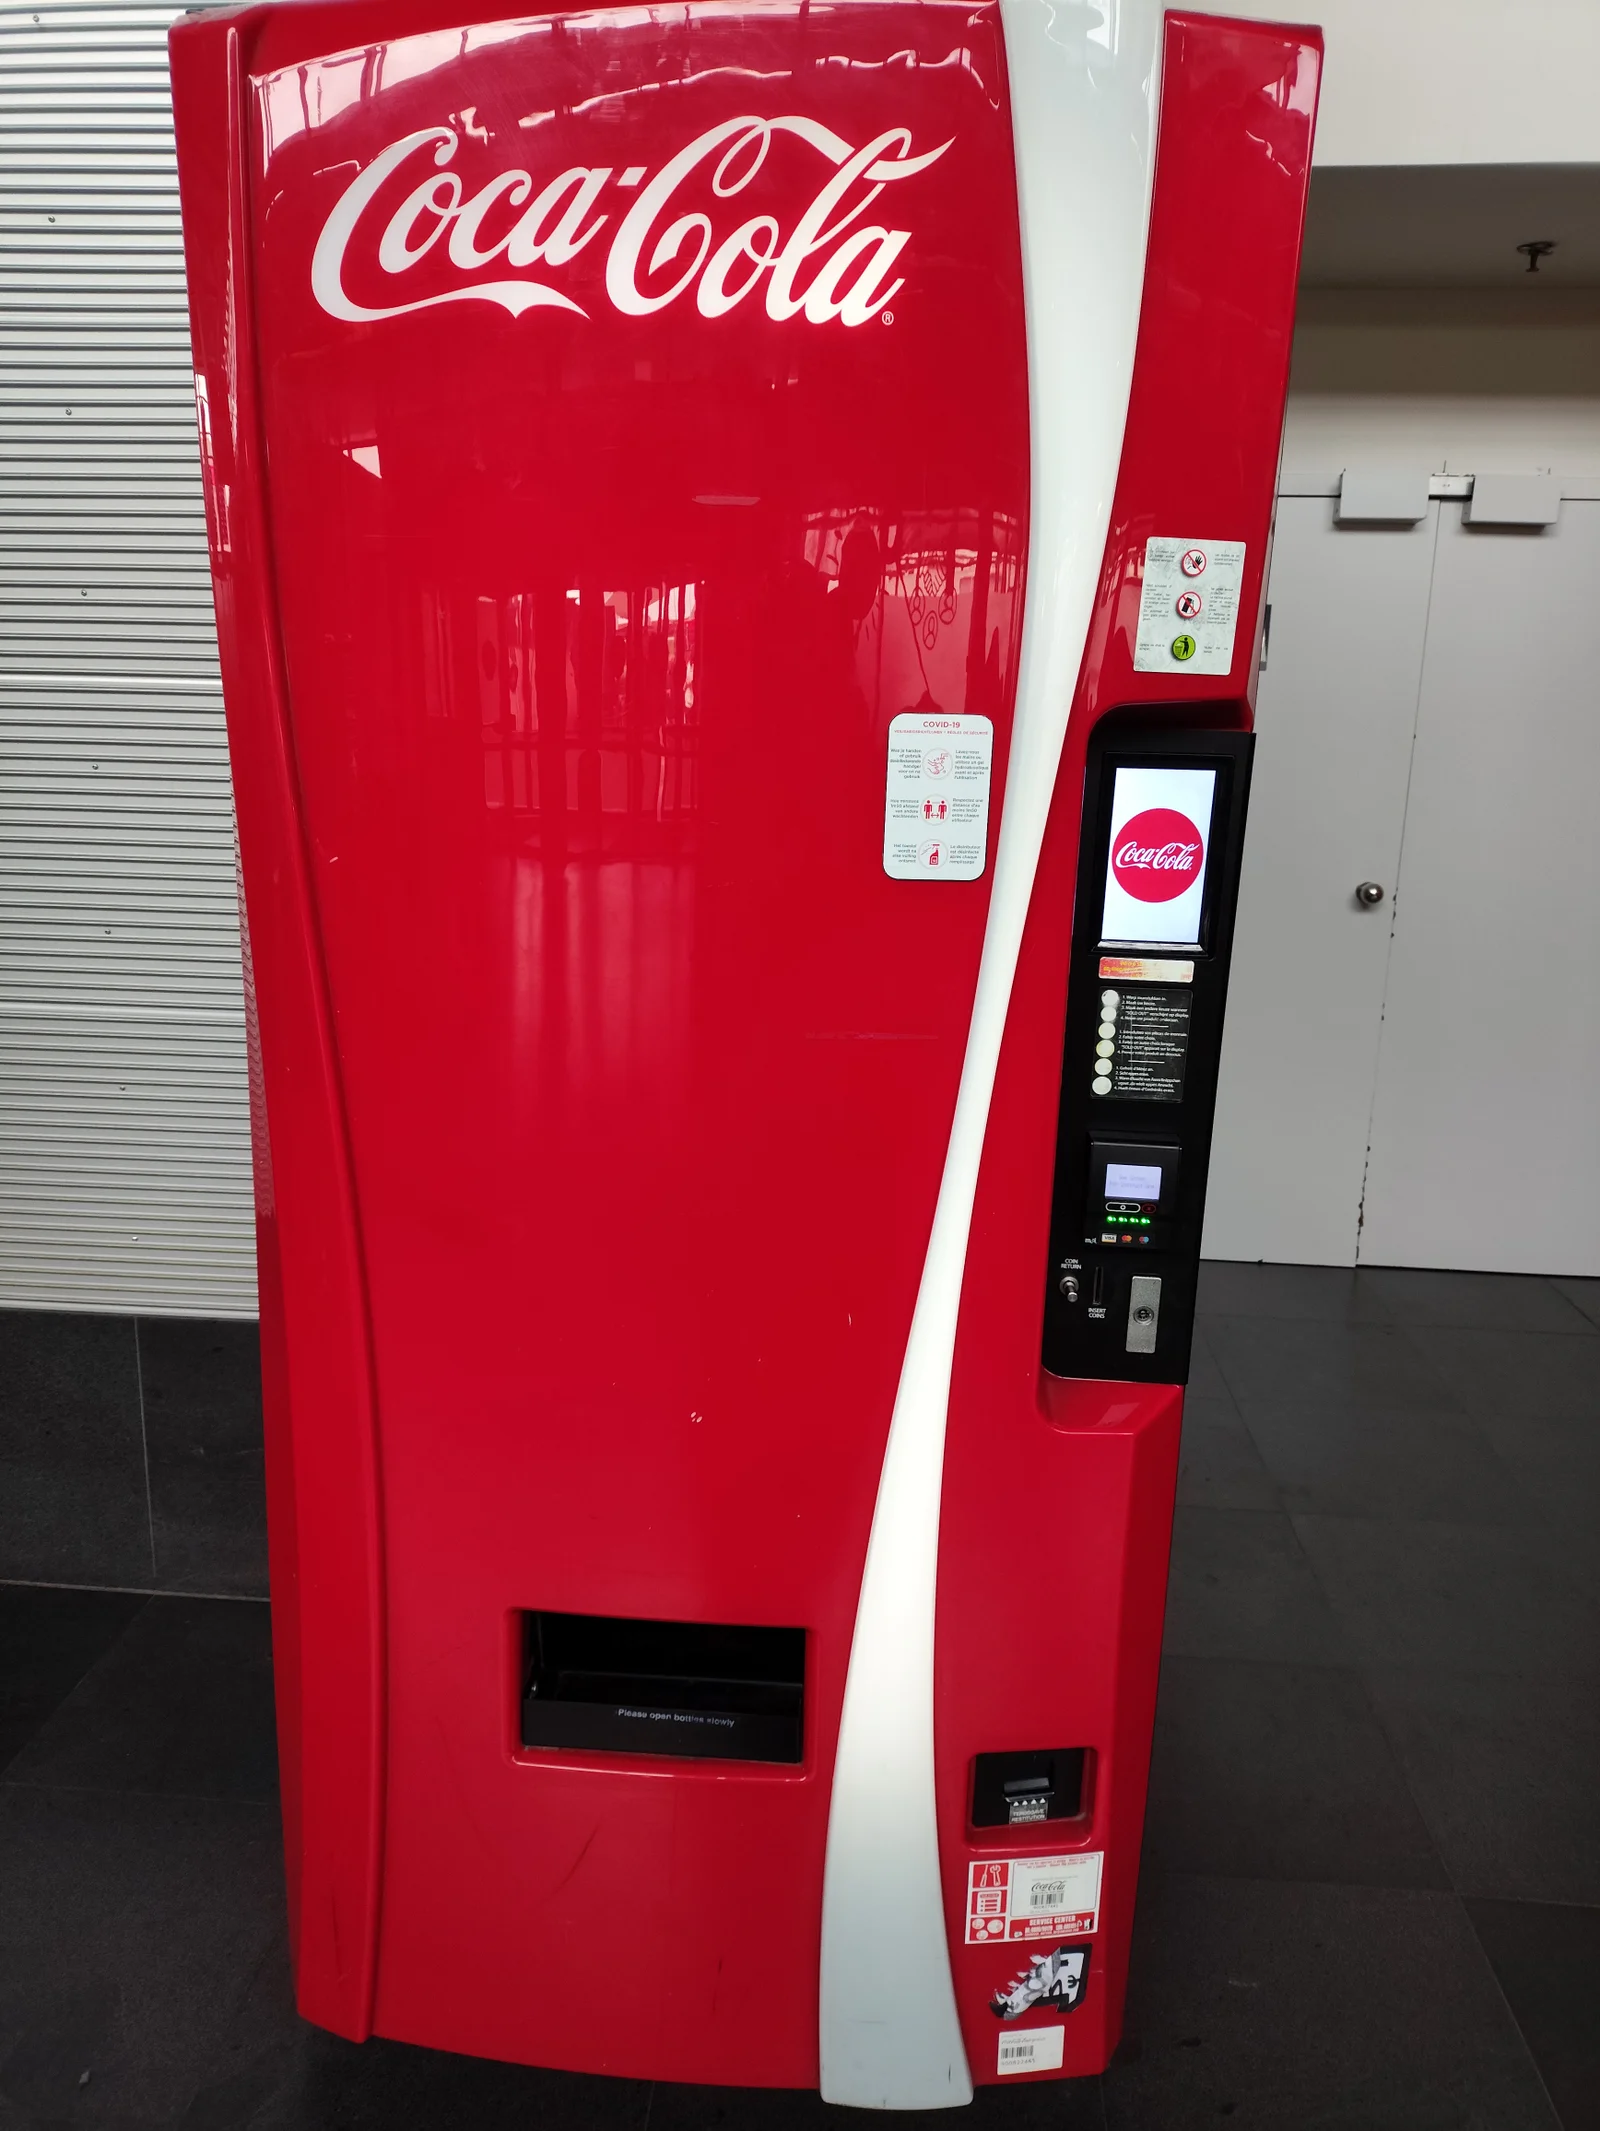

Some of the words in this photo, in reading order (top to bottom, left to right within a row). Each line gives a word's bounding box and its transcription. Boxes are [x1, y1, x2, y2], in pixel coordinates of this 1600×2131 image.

[310, 115, 957, 328] Coca-Cola
[1115, 842, 1200, 870] Coca-Cola
[618, 1709, 647, 1718] Please
[674, 1714, 704, 1723] bottles
[707, 1718, 735, 1728] slowly
[1030, 1918, 1053, 1926] SERVICE
[1054, 1915, 1076, 1923] CENTER
